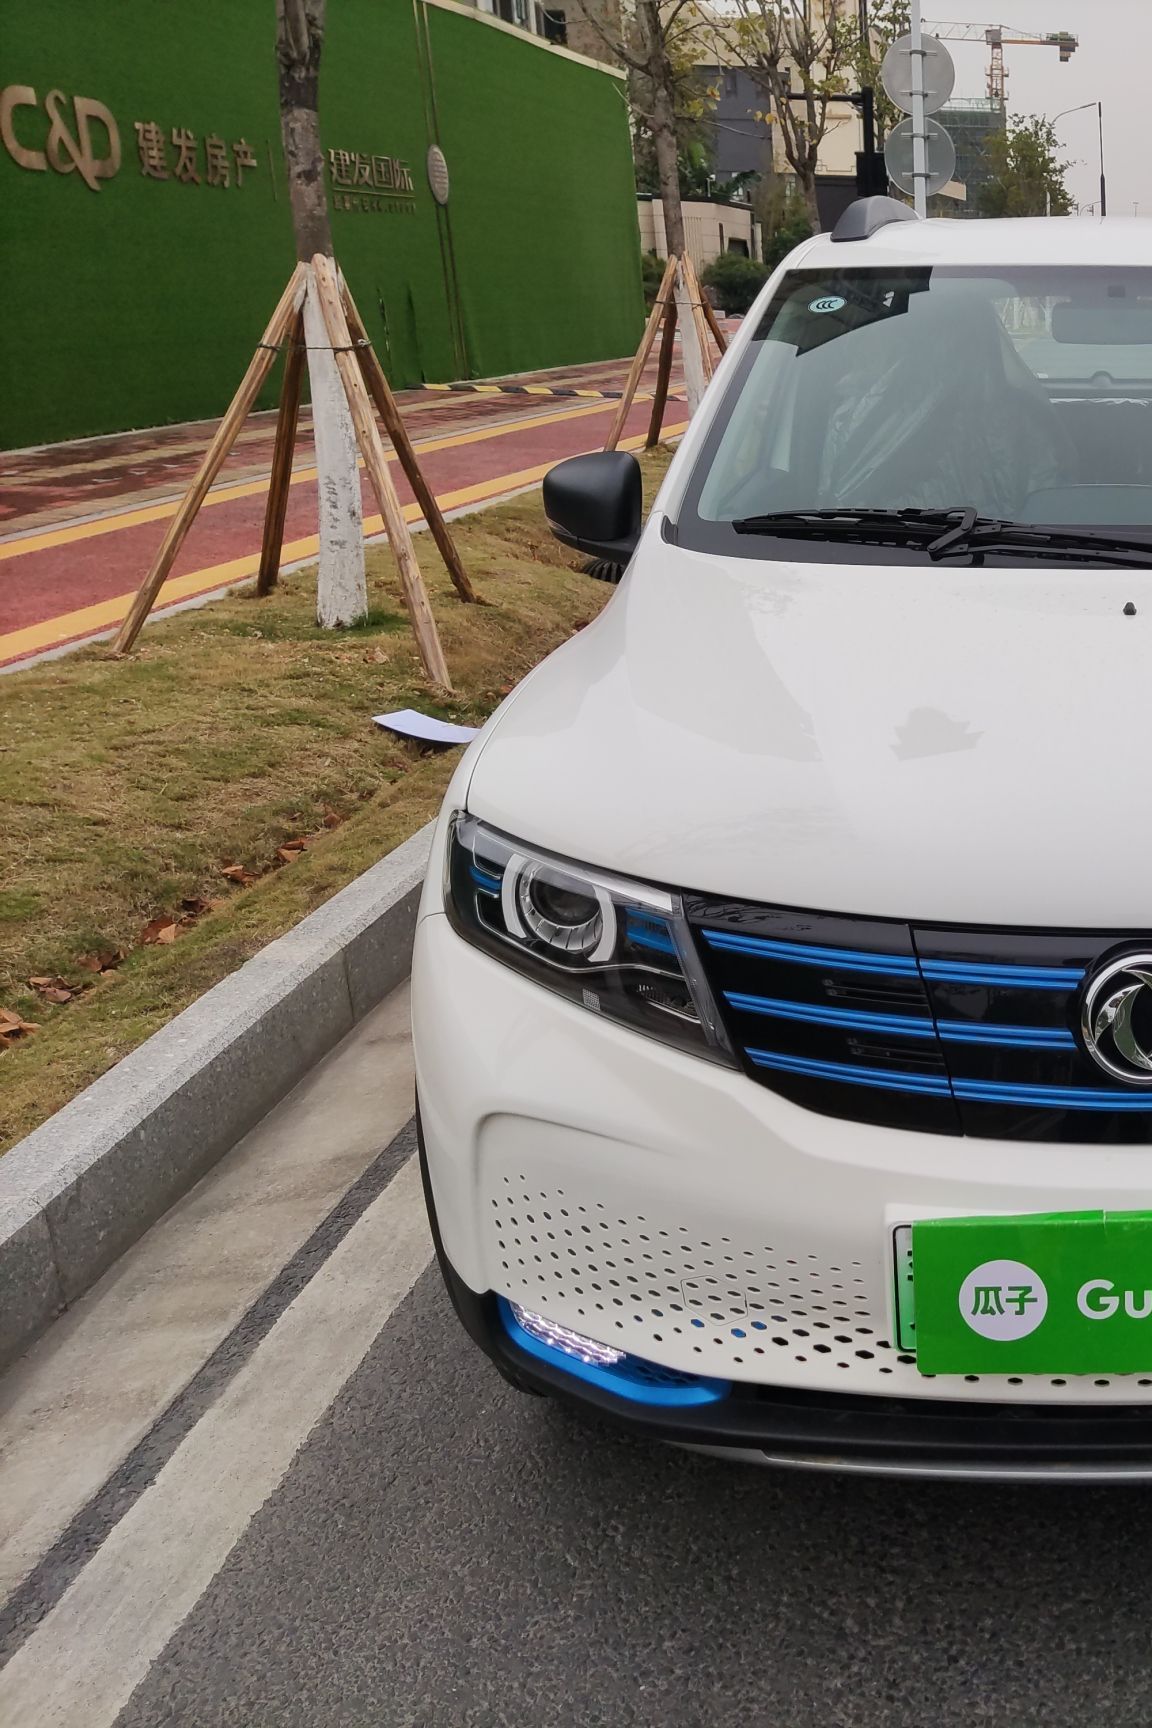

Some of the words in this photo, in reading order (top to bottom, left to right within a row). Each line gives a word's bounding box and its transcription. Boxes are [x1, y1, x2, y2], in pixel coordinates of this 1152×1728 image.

[0, 85, 121, 192] C&D
[134, 121, 257, 189] 建发房产
[328, 148, 414, 191] 建发国际
[971, 1286, 1038, 1316] 瓜子
